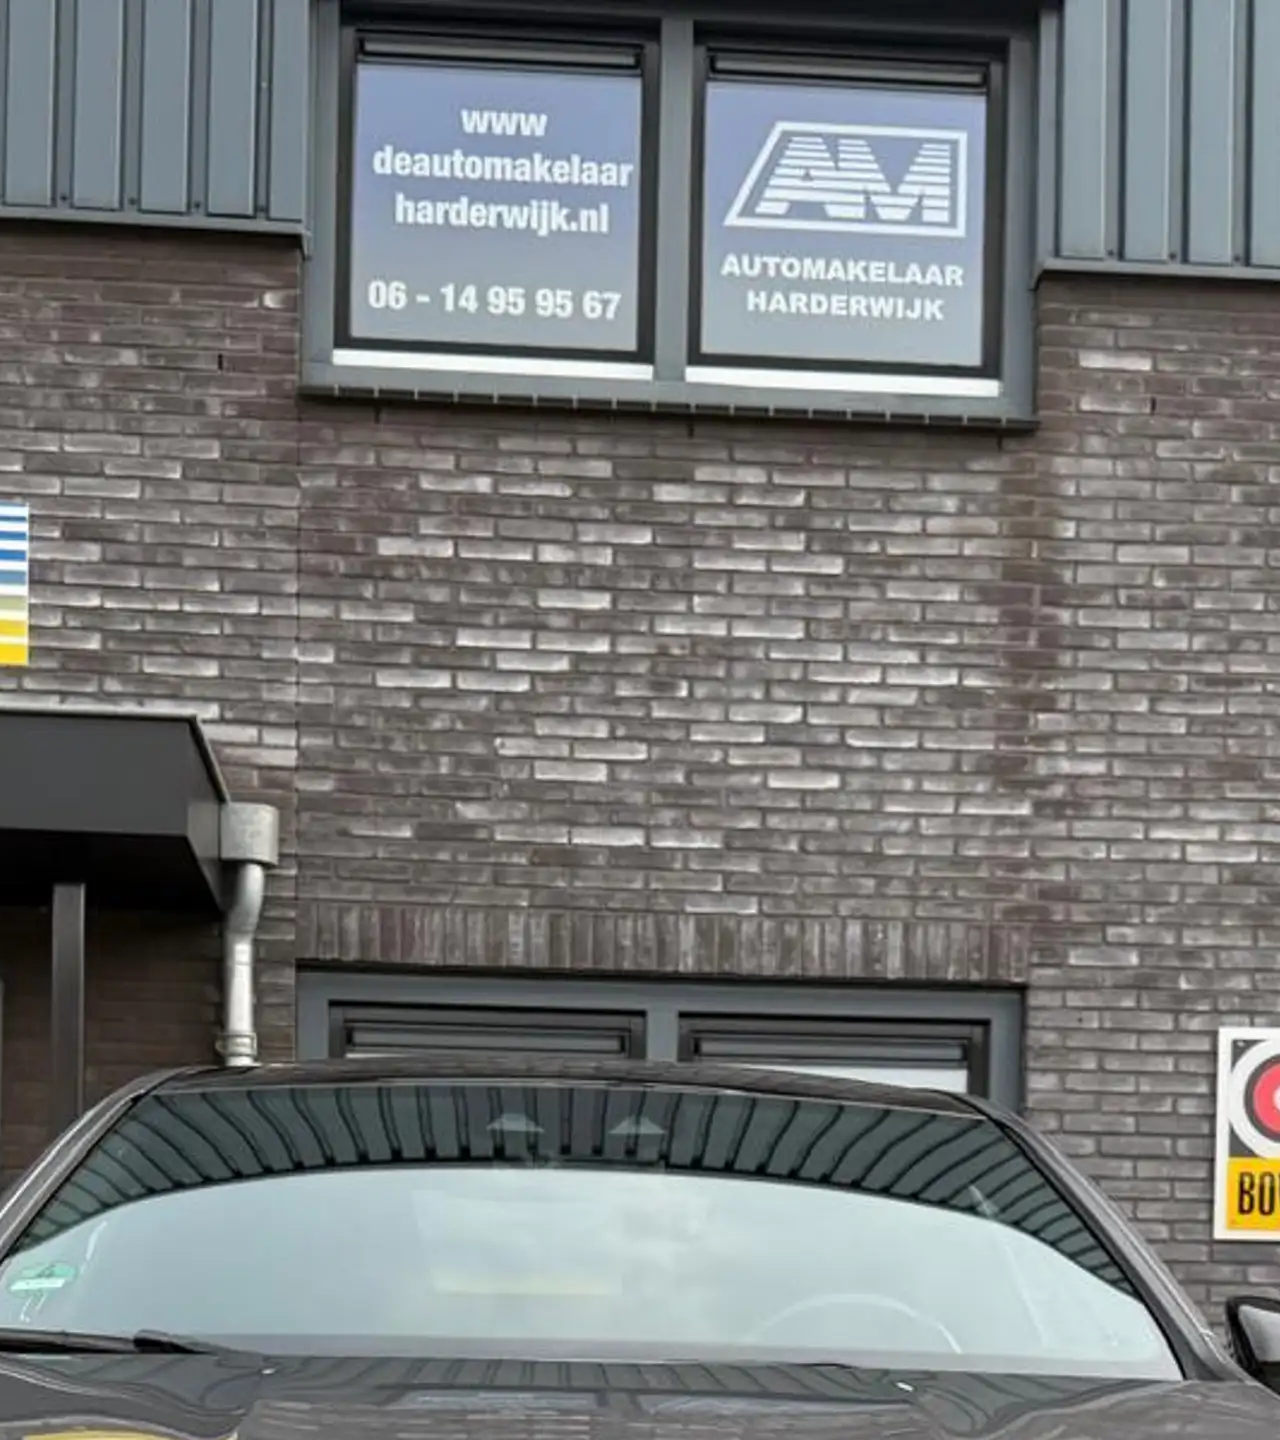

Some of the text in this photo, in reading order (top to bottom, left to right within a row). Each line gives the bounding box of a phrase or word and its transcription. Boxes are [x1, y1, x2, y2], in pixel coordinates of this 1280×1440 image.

[461, 109, 548, 137] www
[373, 145, 633, 187] deautomakelaar
[755, 137, 951, 222] AM
[394, 192, 609, 236] harderwijk.nl
[721, 253, 963, 286] AUTOMAKELAAR
[368, 281, 622, 320] 06 - 14 95 95 67
[747, 290, 944, 320] HARDERWIJK
